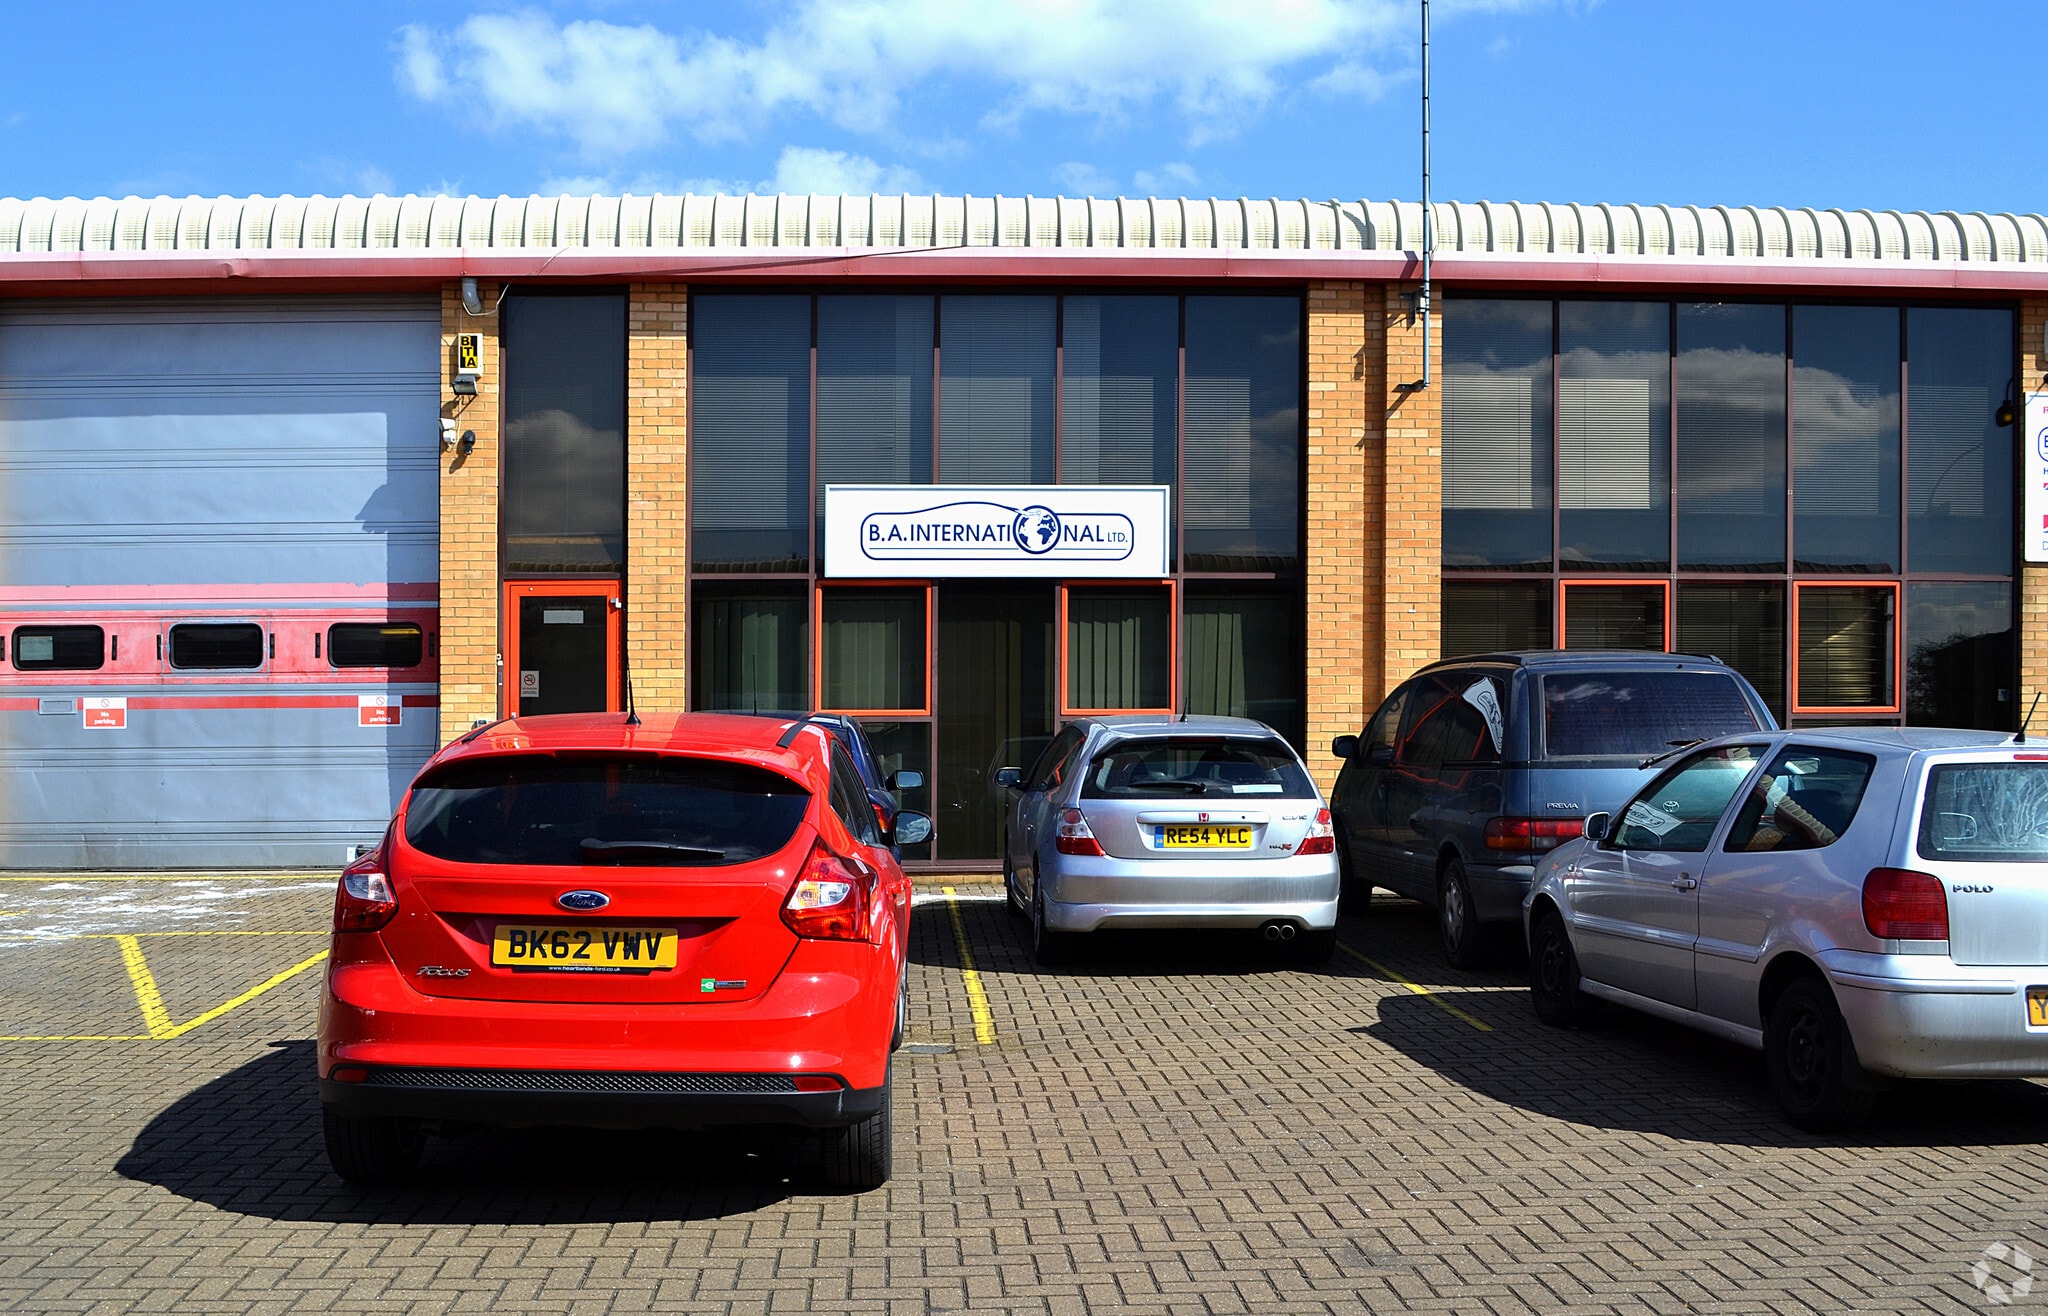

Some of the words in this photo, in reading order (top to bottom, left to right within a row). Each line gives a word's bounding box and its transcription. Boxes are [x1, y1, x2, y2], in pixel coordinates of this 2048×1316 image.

[1107, 532, 1128, 543] LTD.
[369, 716, 392, 724] parking
[1166, 828, 1211, 844] RE54
[1216, 828, 1248, 844] YLC
[1952, 884, 1994, 893] POLO
[569, 894, 598, 906] Ford
[508, 929, 592, 959] BK62
[602, 931, 662, 960] VWV
